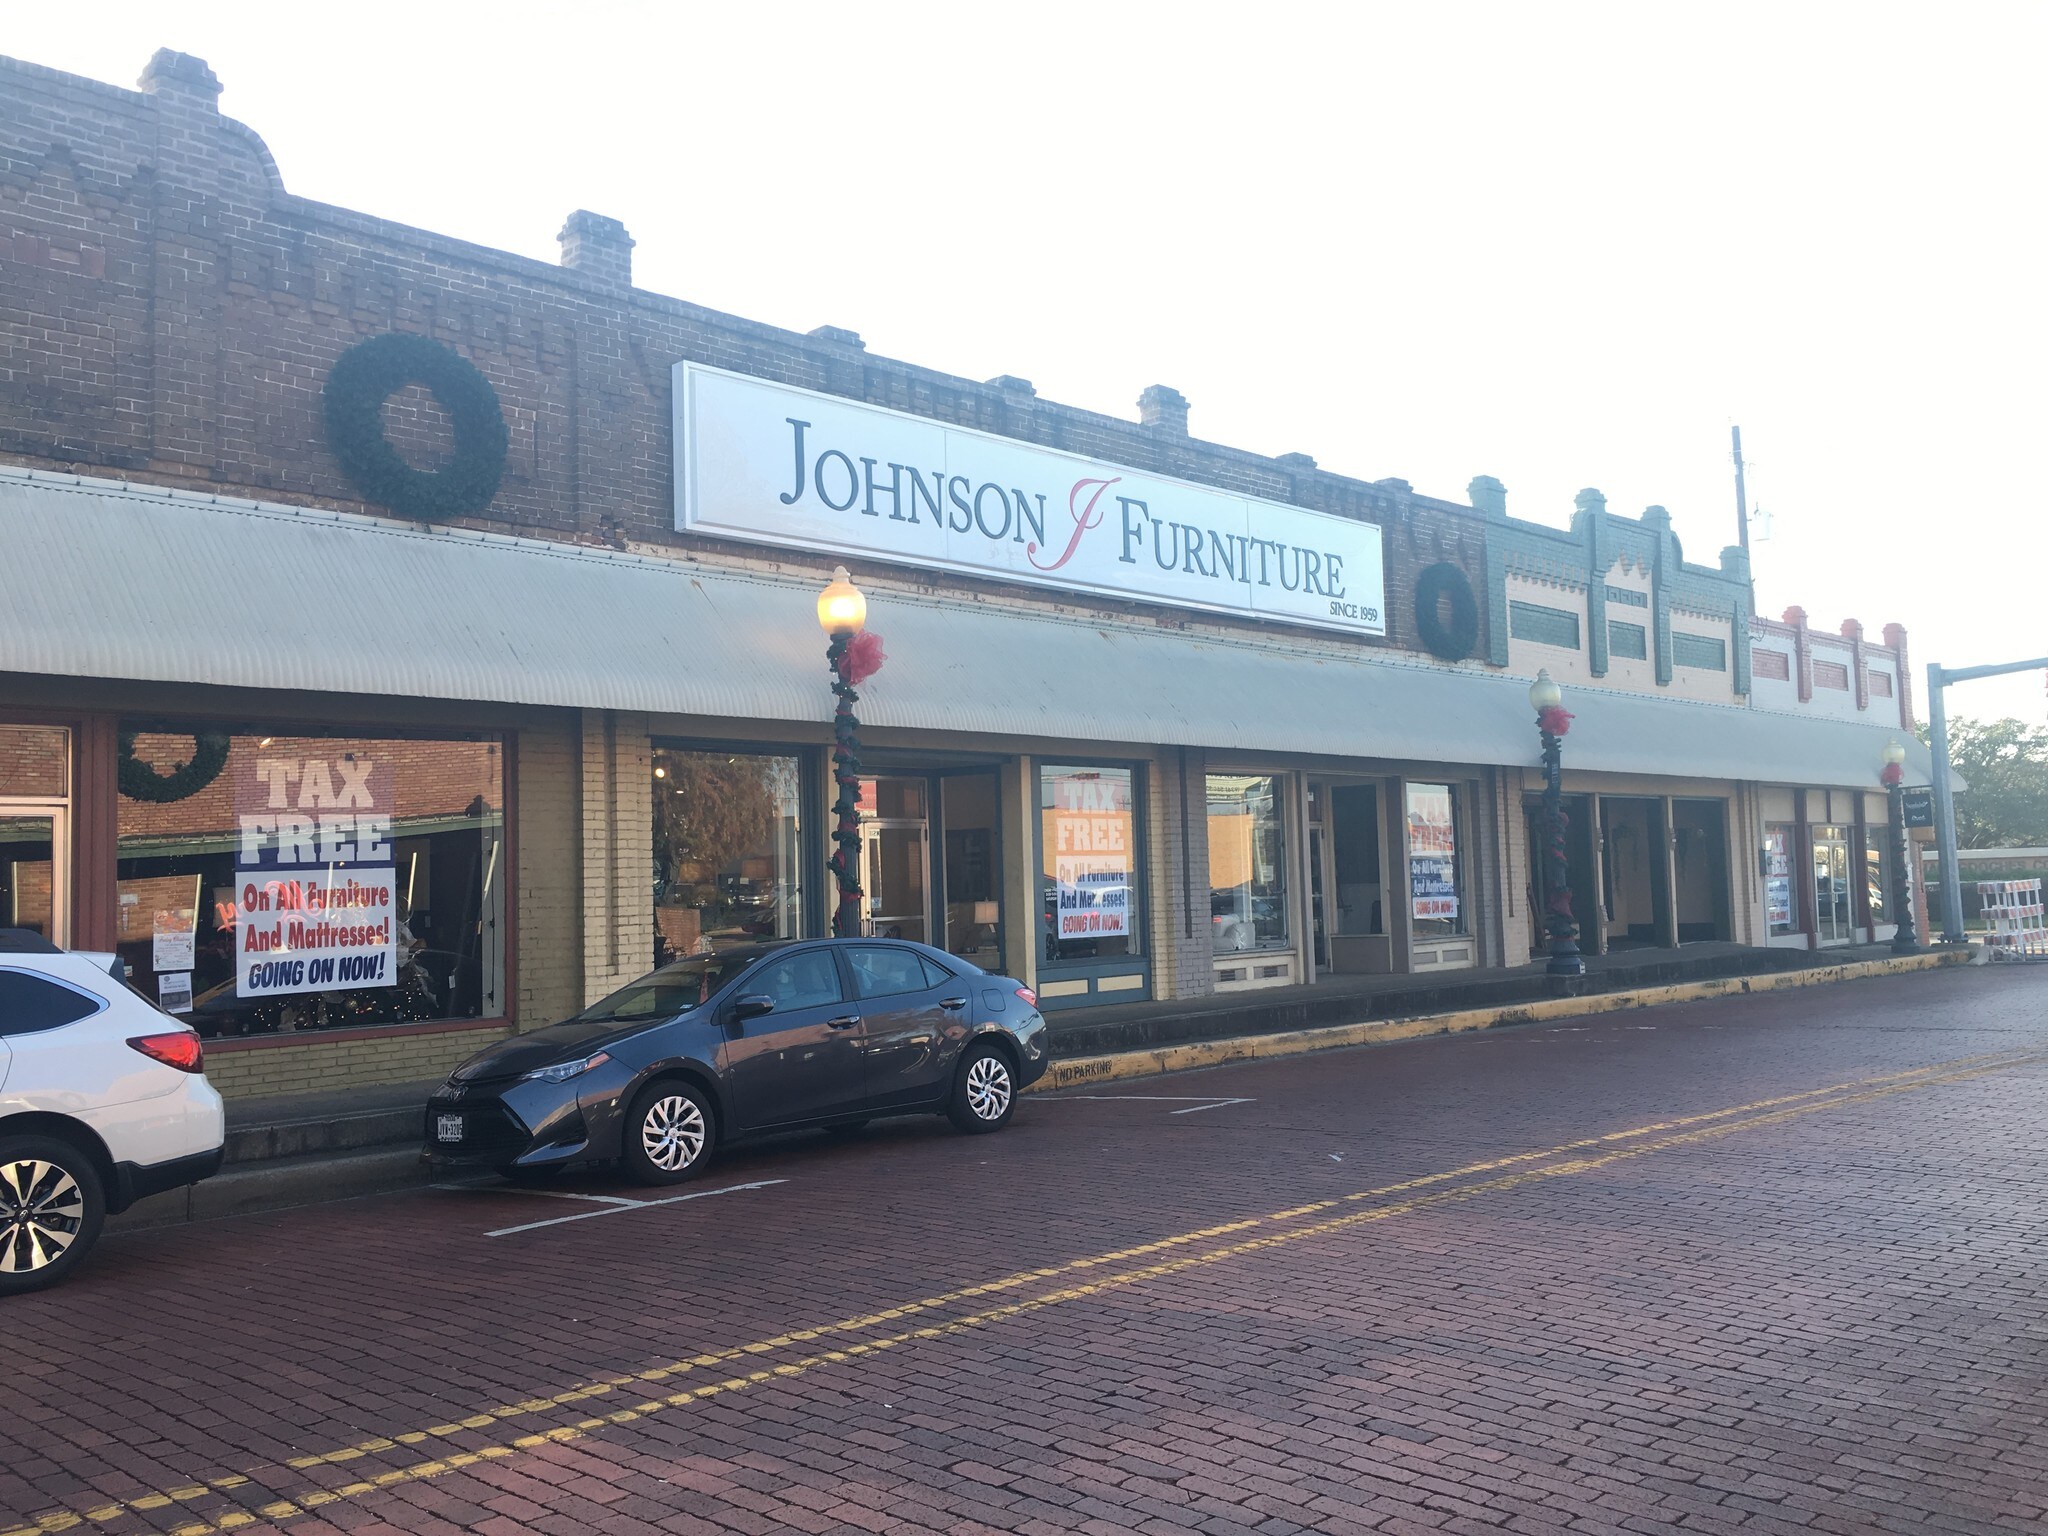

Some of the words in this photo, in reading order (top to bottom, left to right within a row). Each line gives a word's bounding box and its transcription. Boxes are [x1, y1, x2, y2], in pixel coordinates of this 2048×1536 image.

[779, 417, 1047, 548] JOHNSON
[1116, 495, 1346, 599] FURNITURE
[1330, 601, 1358, 619] SINCE
[1360, 606, 1378, 622] 1959
[256, 759, 374, 808] TAX
[1063, 782, 1116, 814] TAX
[239, 814, 391, 864] FREE
[1056, 817, 1125, 851] FREE
[1060, 864, 1071, 882] On
[1073, 862, 1085, 882] All
[1087, 861, 1124, 882] Furniture
[243, 883, 270, 912] On
[276, 881, 301, 911] All
[308, 878, 389, 910] Furniture
[1060, 889, 1077, 909] And
[244, 921, 282, 952] And
[288, 917, 389, 950] Mattresses!
[1063, 914, 1087, 934] GOING
[1089, 913, 1101, 932] ON
[1102, 912, 1124, 931] NOW!
[249, 958, 304, 989] GOING
[308, 957, 335, 985] ON
[338, 952, 386, 982] NOW!
[1060, 1067, 1072, 1082] NO
[1074, 1060, 1112, 1079] PARKING
